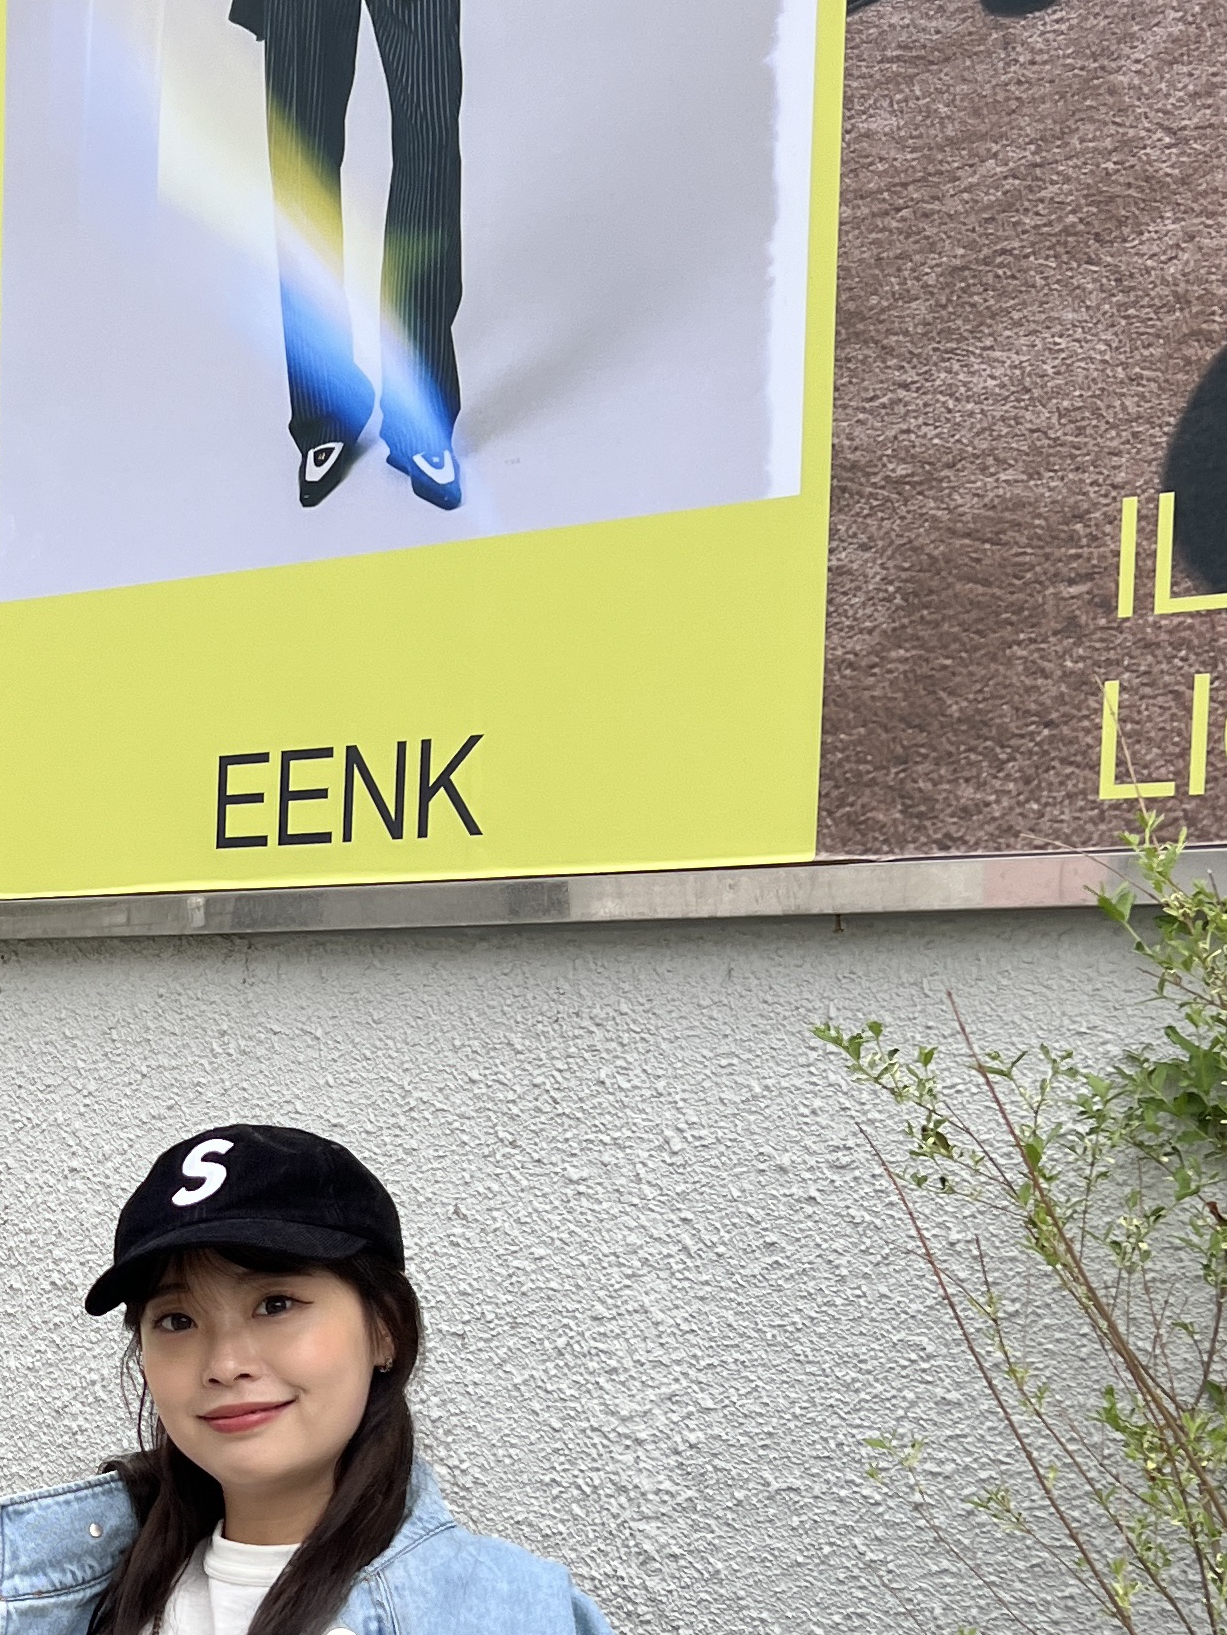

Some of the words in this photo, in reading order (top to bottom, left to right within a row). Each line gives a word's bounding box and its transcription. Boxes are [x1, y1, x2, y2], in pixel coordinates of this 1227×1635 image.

[215, 733, 485, 850] EENK
[1098, 673, 1227, 800] LI
[171, 1138, 235, 1207] S
